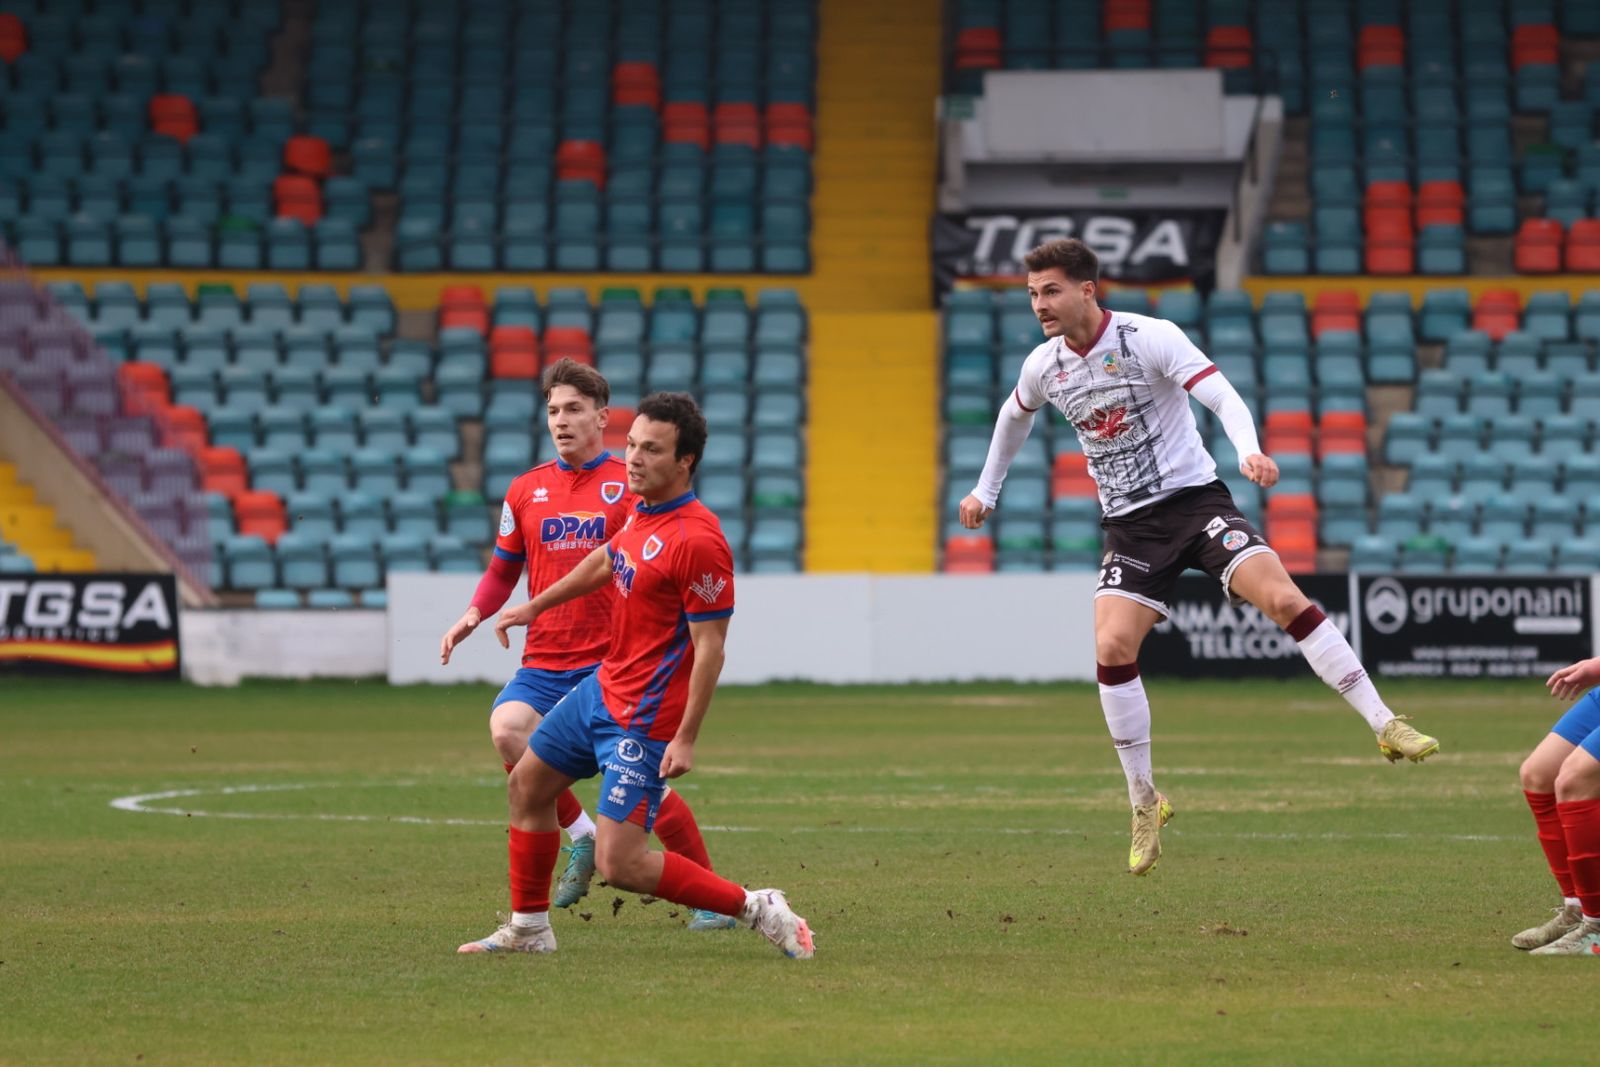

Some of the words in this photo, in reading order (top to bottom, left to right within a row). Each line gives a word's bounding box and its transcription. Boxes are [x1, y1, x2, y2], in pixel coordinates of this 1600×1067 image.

[541, 516, 606, 544] DPM
[1096, 566, 1122, 591] 23
[1411, 581, 1583, 624] gruponani
